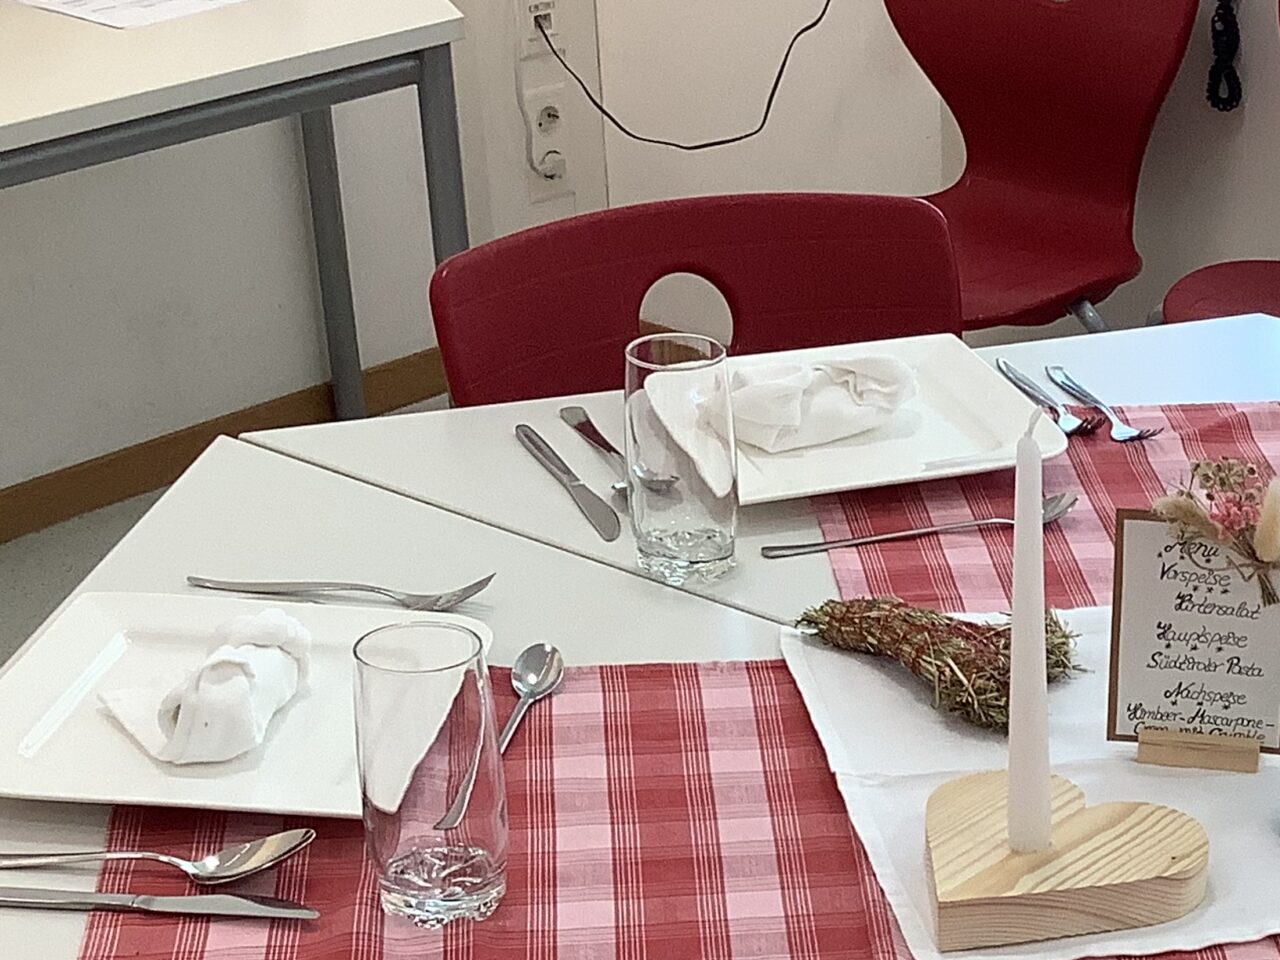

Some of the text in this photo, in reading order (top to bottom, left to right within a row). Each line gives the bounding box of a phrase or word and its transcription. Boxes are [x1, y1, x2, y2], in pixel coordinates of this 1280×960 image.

[1160, 562, 1231, 588] Vorspeise
[1174, 591, 1261, 620] Hirtensalat
[1156, 621, 1248, 648] Hauptspeise
[1226, 656, 1264, 677] Pasta
[1164, 682, 1247, 705] Nachspeise
